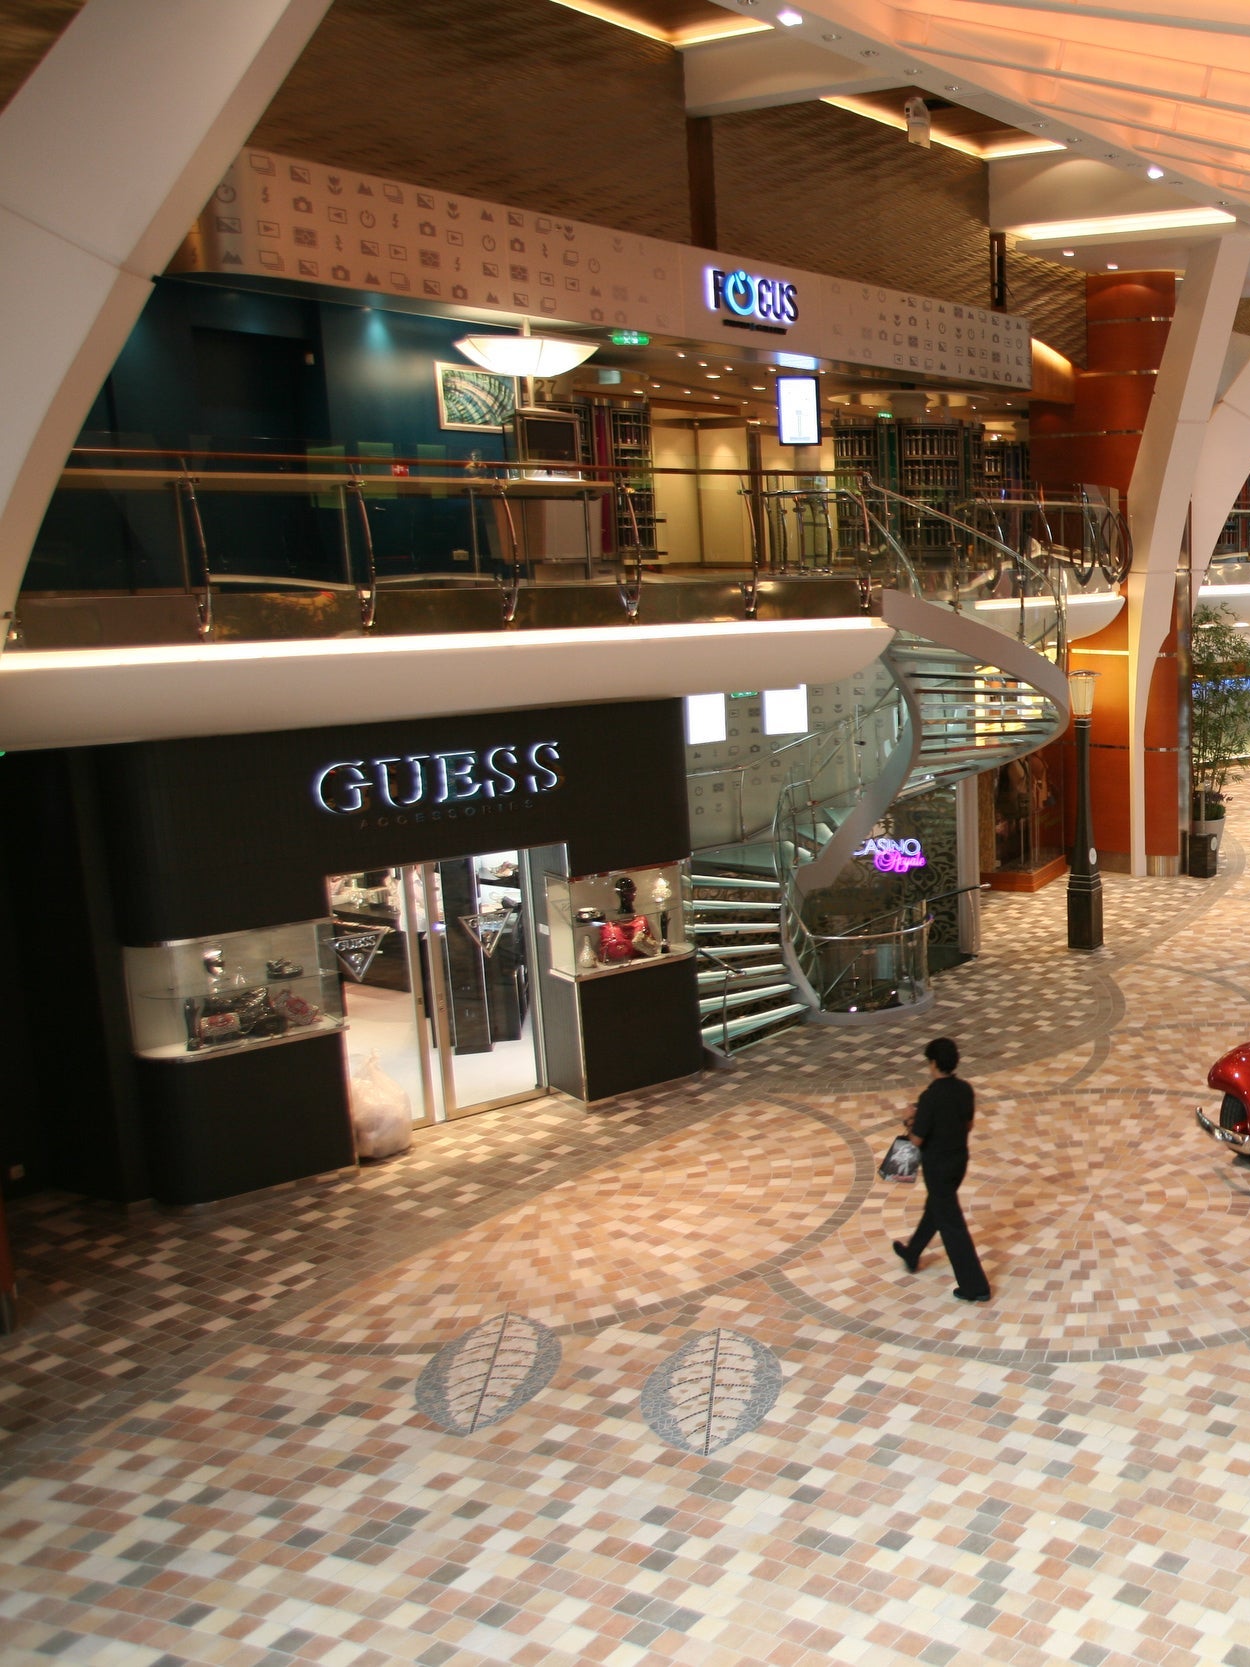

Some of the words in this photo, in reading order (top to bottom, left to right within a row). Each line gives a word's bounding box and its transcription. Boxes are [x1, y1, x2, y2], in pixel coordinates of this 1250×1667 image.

[705, 268, 799, 323] FOCUS
[316, 742, 565, 815] GUESS
[360, 800, 534, 830] ACCESSORIES
[335, 935, 377, 952] GUESS
